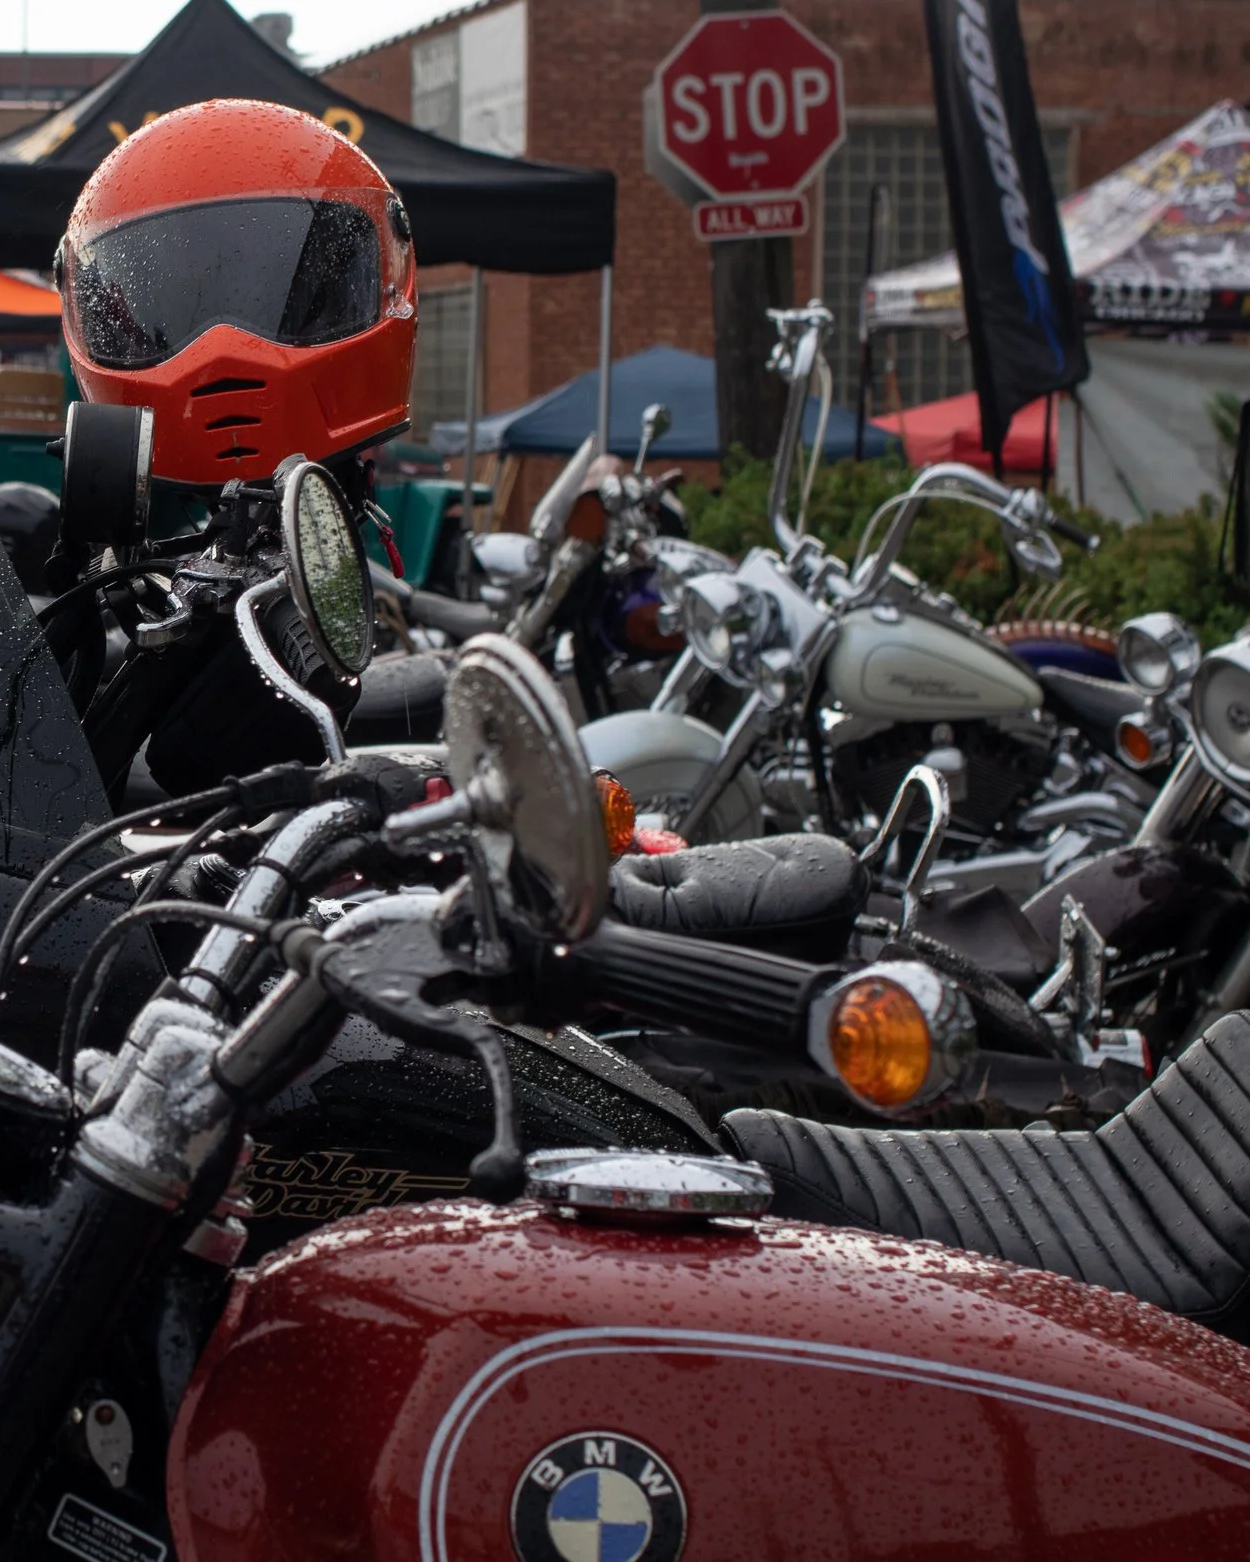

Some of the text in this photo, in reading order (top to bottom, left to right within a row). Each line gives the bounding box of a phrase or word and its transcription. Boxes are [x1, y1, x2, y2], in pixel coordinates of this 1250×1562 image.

[672, 69, 831, 144] STOP
[957, 0, 1048, 276] PROG
[707, 203, 797, 233] ALL WAY
[530, 1439, 674, 1498] BMW
